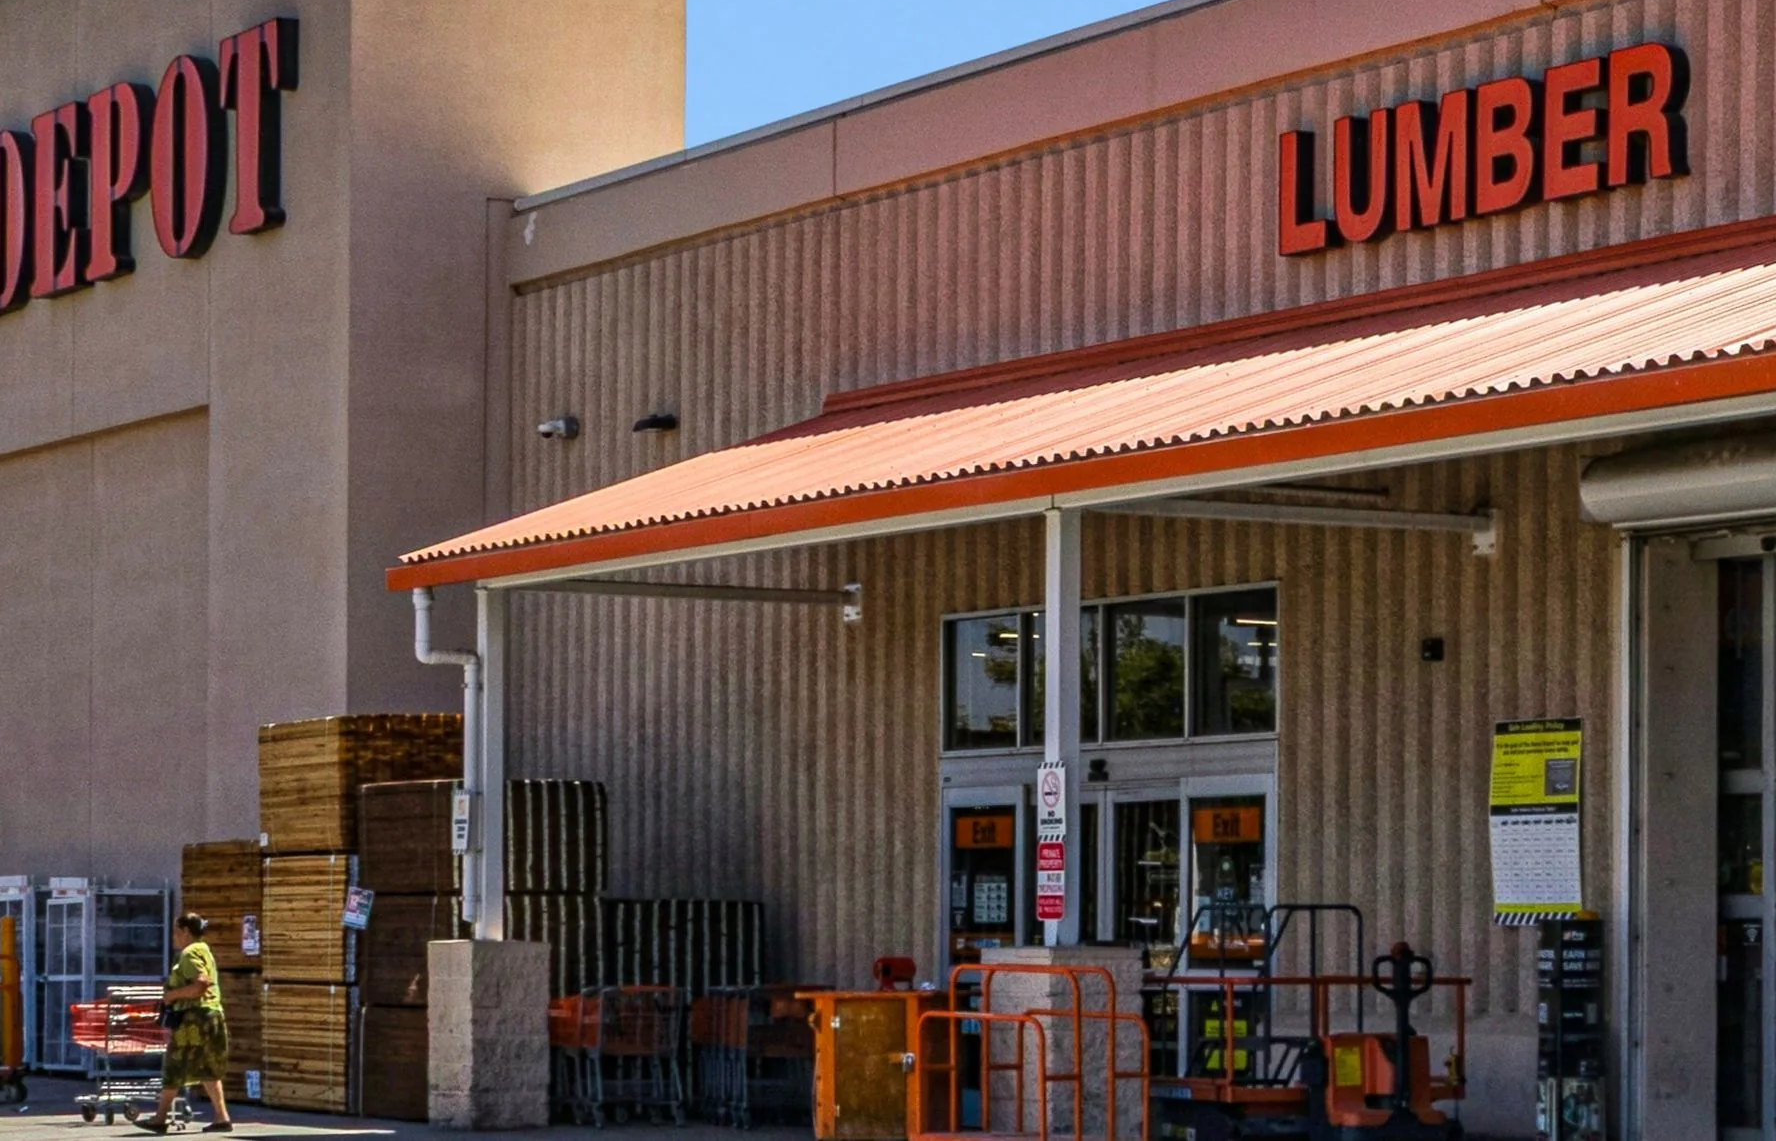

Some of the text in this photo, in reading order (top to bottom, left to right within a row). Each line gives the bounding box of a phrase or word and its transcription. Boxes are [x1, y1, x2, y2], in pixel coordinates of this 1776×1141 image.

[1279, 42, 1690, 255] LUMBER
[972, 821, 997, 843] Exit
[1212, 811, 1241, 837] Exit
